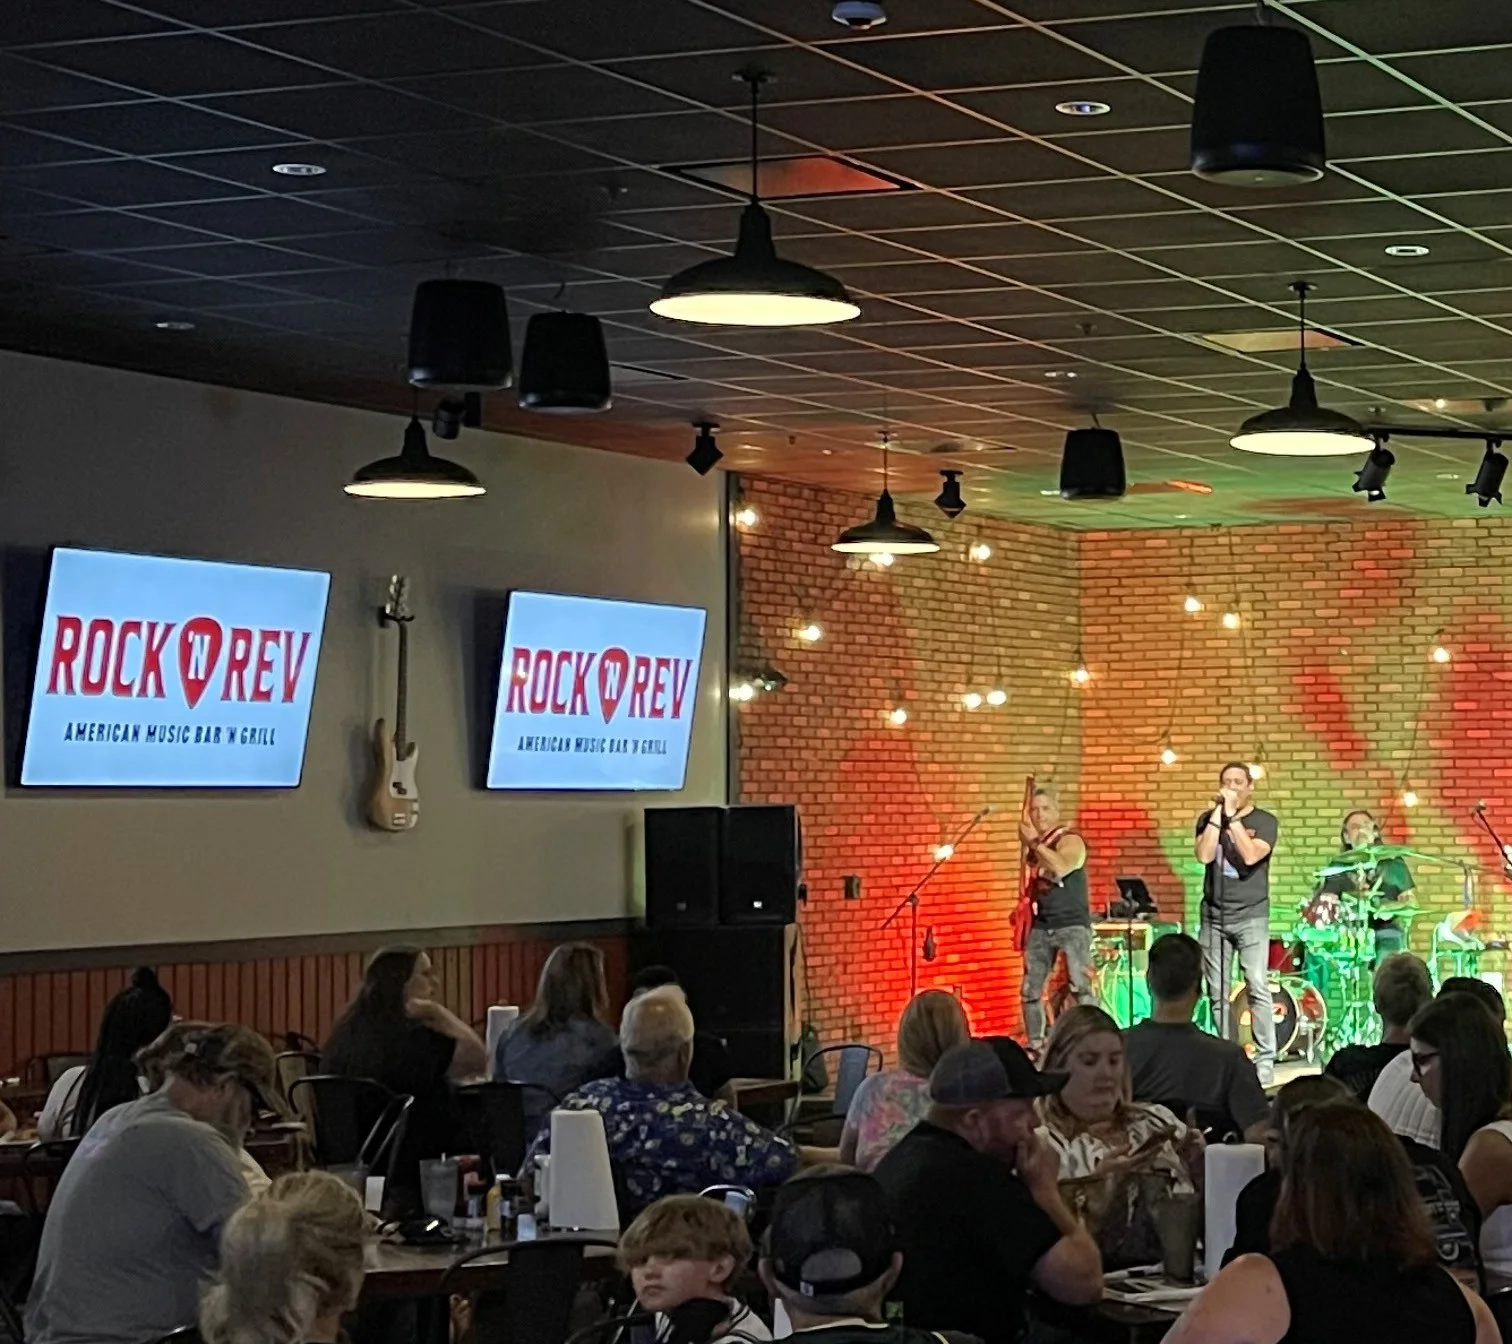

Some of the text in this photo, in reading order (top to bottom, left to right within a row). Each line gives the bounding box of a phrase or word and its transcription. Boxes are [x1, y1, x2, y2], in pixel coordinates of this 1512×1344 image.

[46, 615, 177, 698] ROCK
[219, 626, 312, 704] REV
[505, 646, 597, 716] ROCK
[627, 655, 693, 720] REV
[63, 721, 140, 744] AMERICAN
[145, 724, 192, 745] MUSIC
[193, 725, 221, 745] BAR
[239, 726, 276, 746] GRILL
[516, 735, 571, 753] AMERICAN
[573, 736, 607, 754] MUSIC
[608, 738, 629, 754] BAR
[641, 739, 668, 756] GRILL
